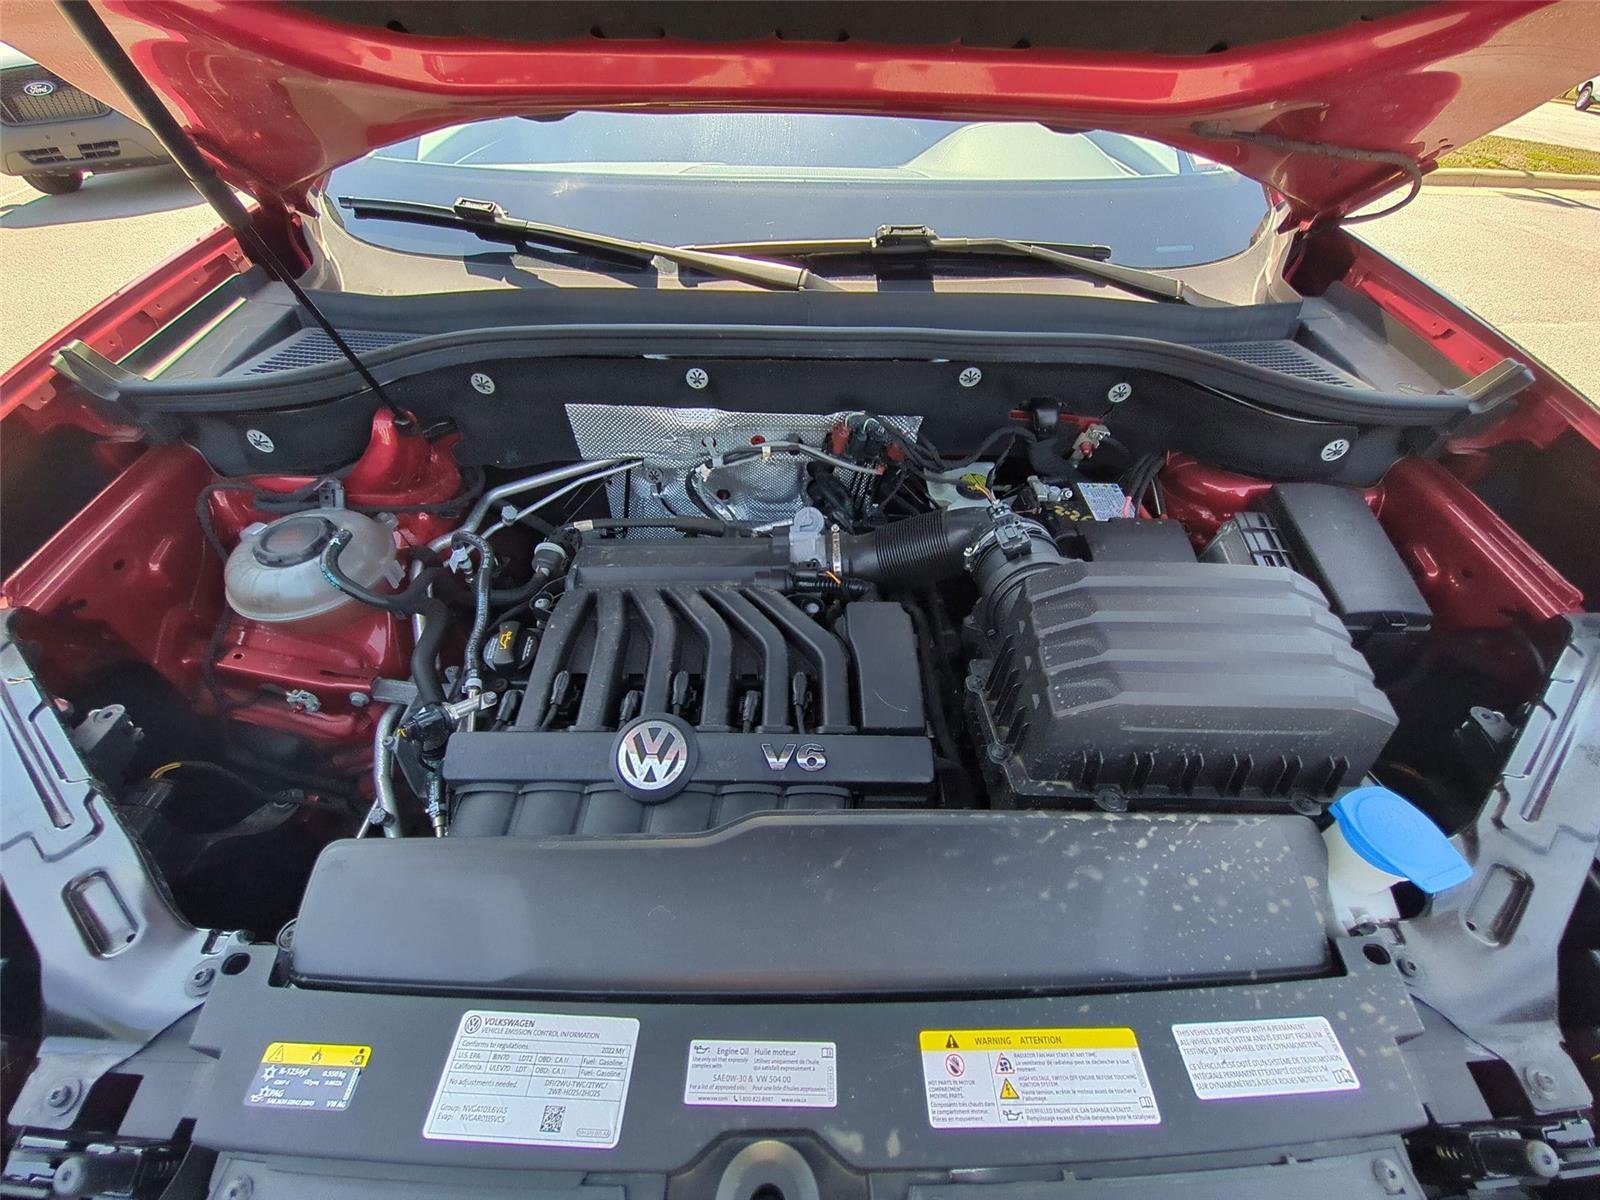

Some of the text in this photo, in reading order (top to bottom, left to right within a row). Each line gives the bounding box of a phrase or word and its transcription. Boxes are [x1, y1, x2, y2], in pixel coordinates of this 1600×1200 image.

[29, 84, 48, 94] Ford
[761, 743, 827, 772] V6
[484, 1018, 535, 1027] VOLKSWAGEN
[533, 1029, 559, 1037] CONTROL
[560, 1031, 600, 1039] INFORMATION
[1189, 1028, 1213, 1036] VEHICLE
[1271, 1023, 1305, 1031] PERMANENT
[974, 1035, 1063, 1046] WARNING ATTENTION
[717, 1047, 738, 1056] Engine
[754, 1047, 796, 1055] Huile moteur
[454, 1062, 482, 1070] California
[279, 1068, 310, 1076] R-1234yf
[596, 1069, 621, 1077] Gasoline
[458, 1078, 495, 1088] adjustments
